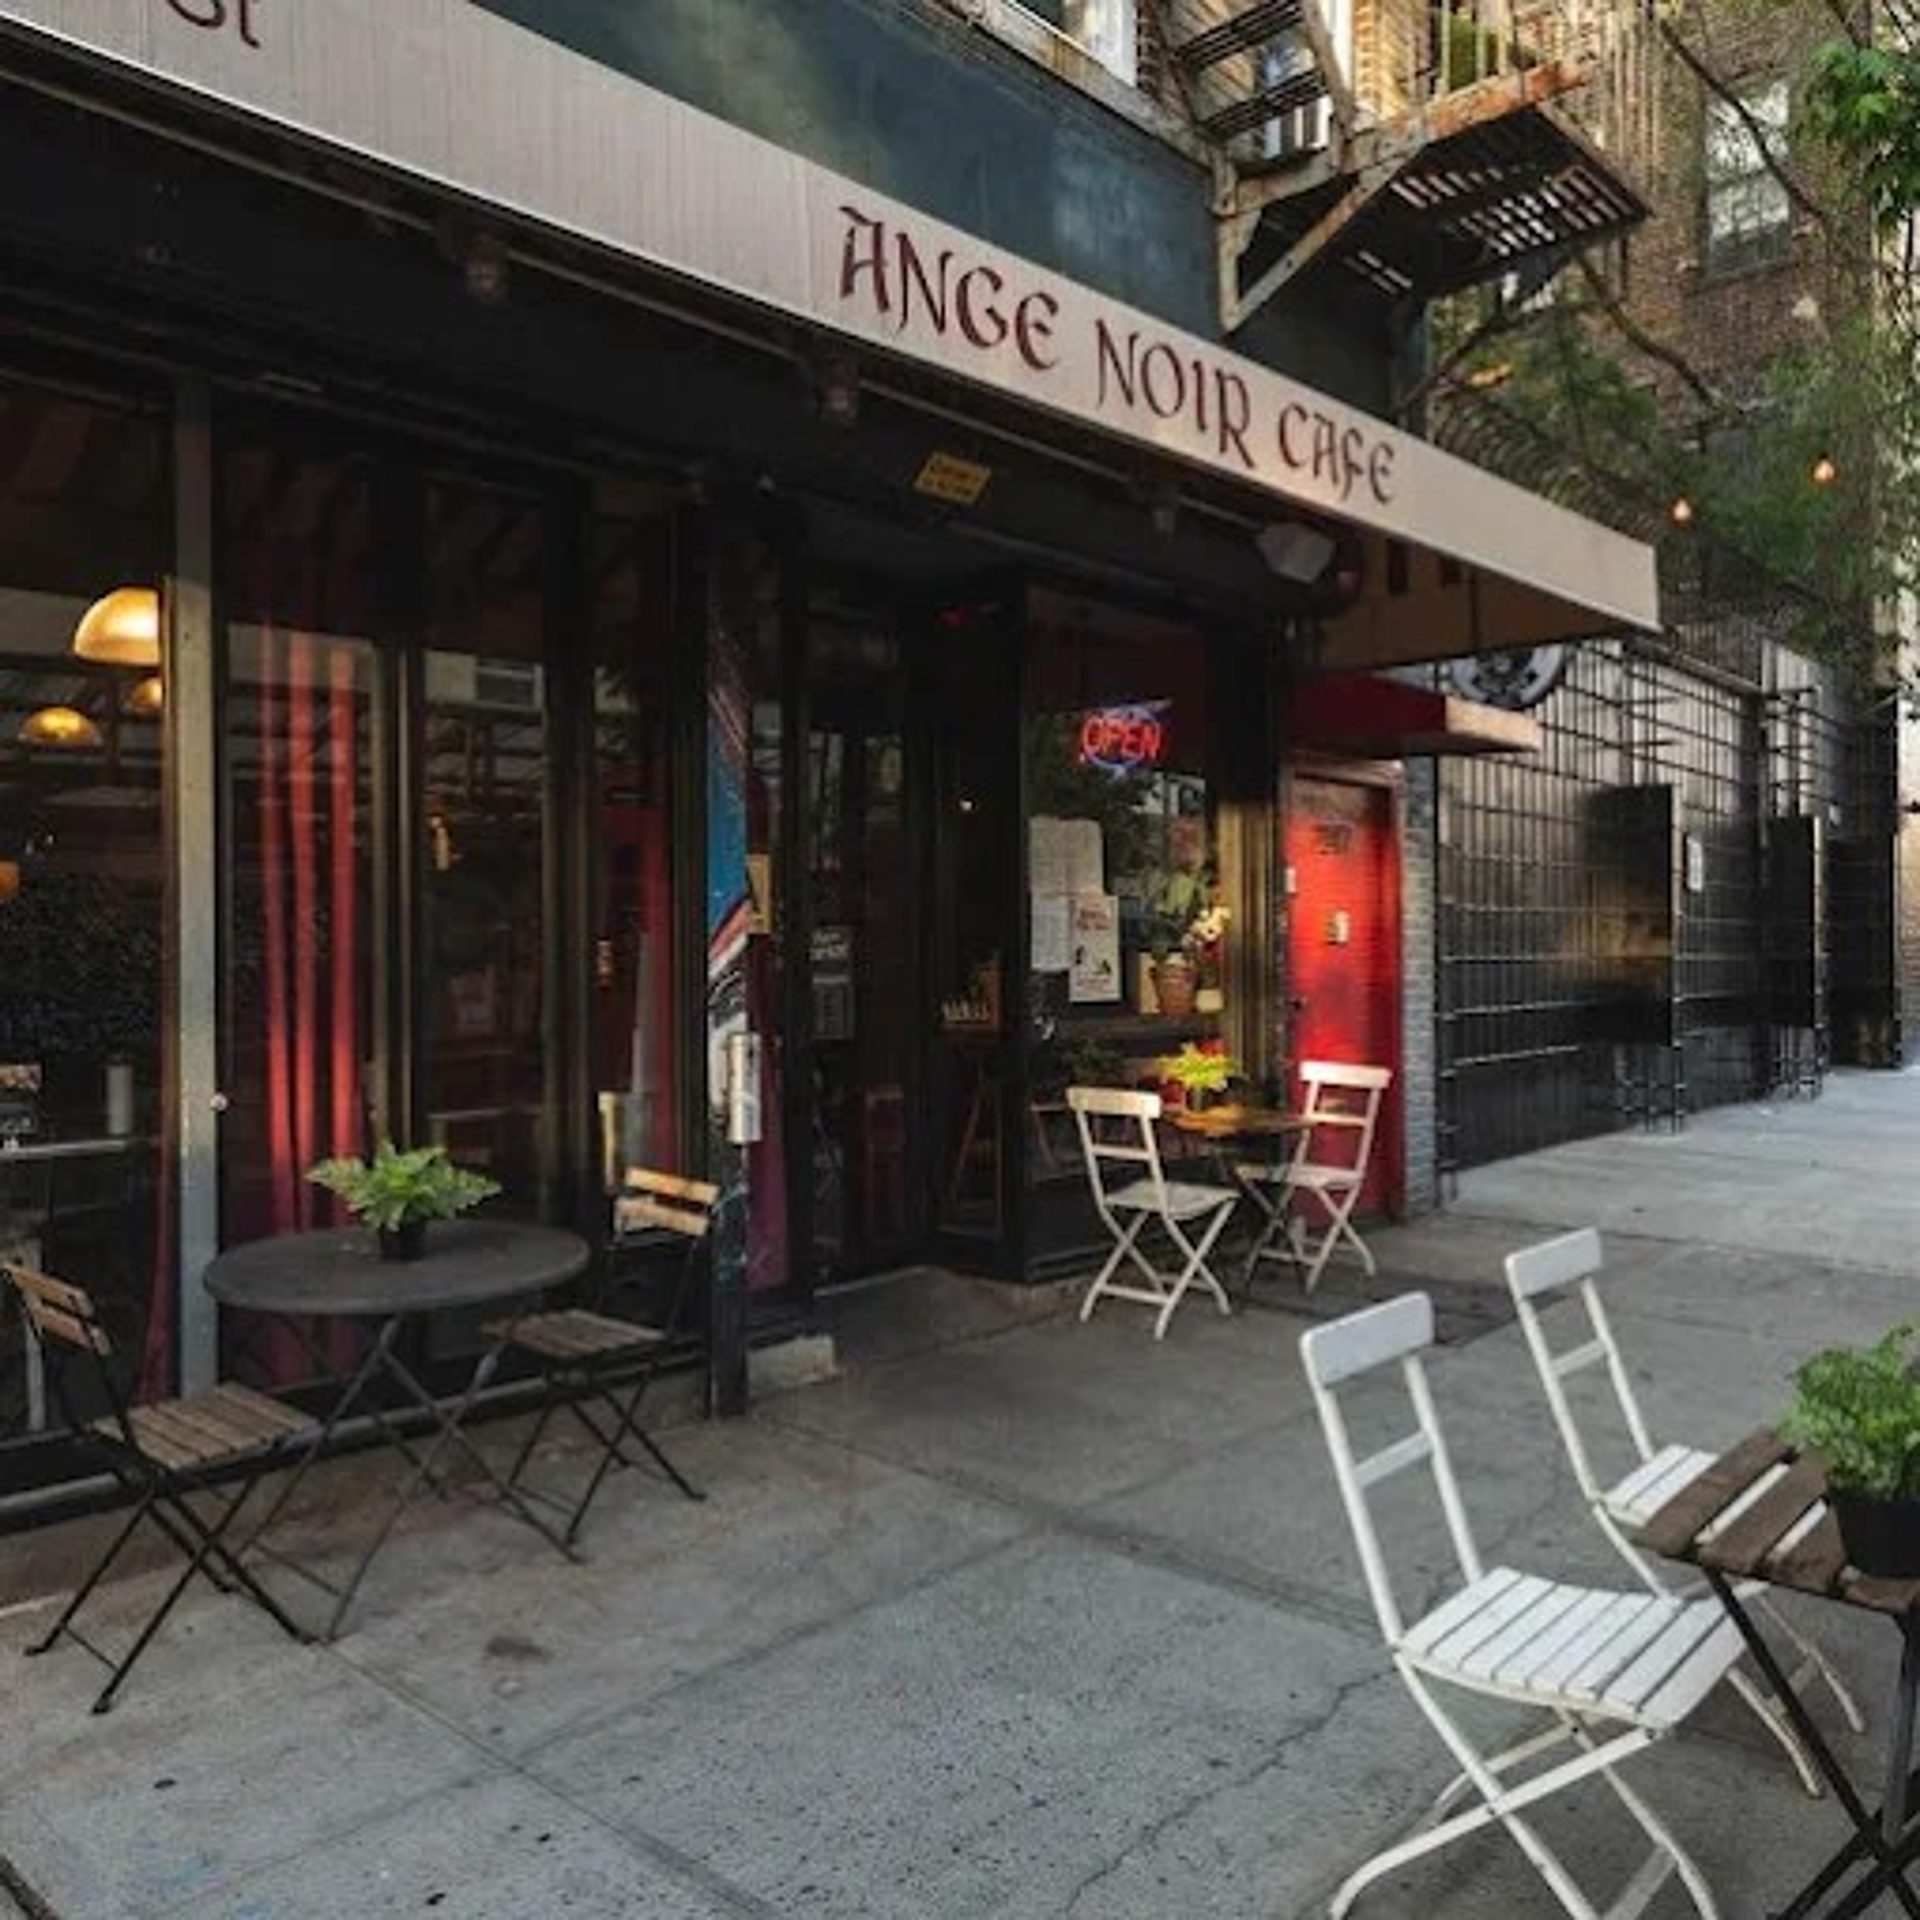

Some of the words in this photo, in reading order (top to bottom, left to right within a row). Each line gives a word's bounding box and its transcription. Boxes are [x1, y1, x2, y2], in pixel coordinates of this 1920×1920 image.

[838, 205, 1059, 371] ANGE
[1095, 317, 1256, 469] NOIR
[1277, 403, 1396, 505] CAFE
[1081, 713, 1161, 758] OPEN
